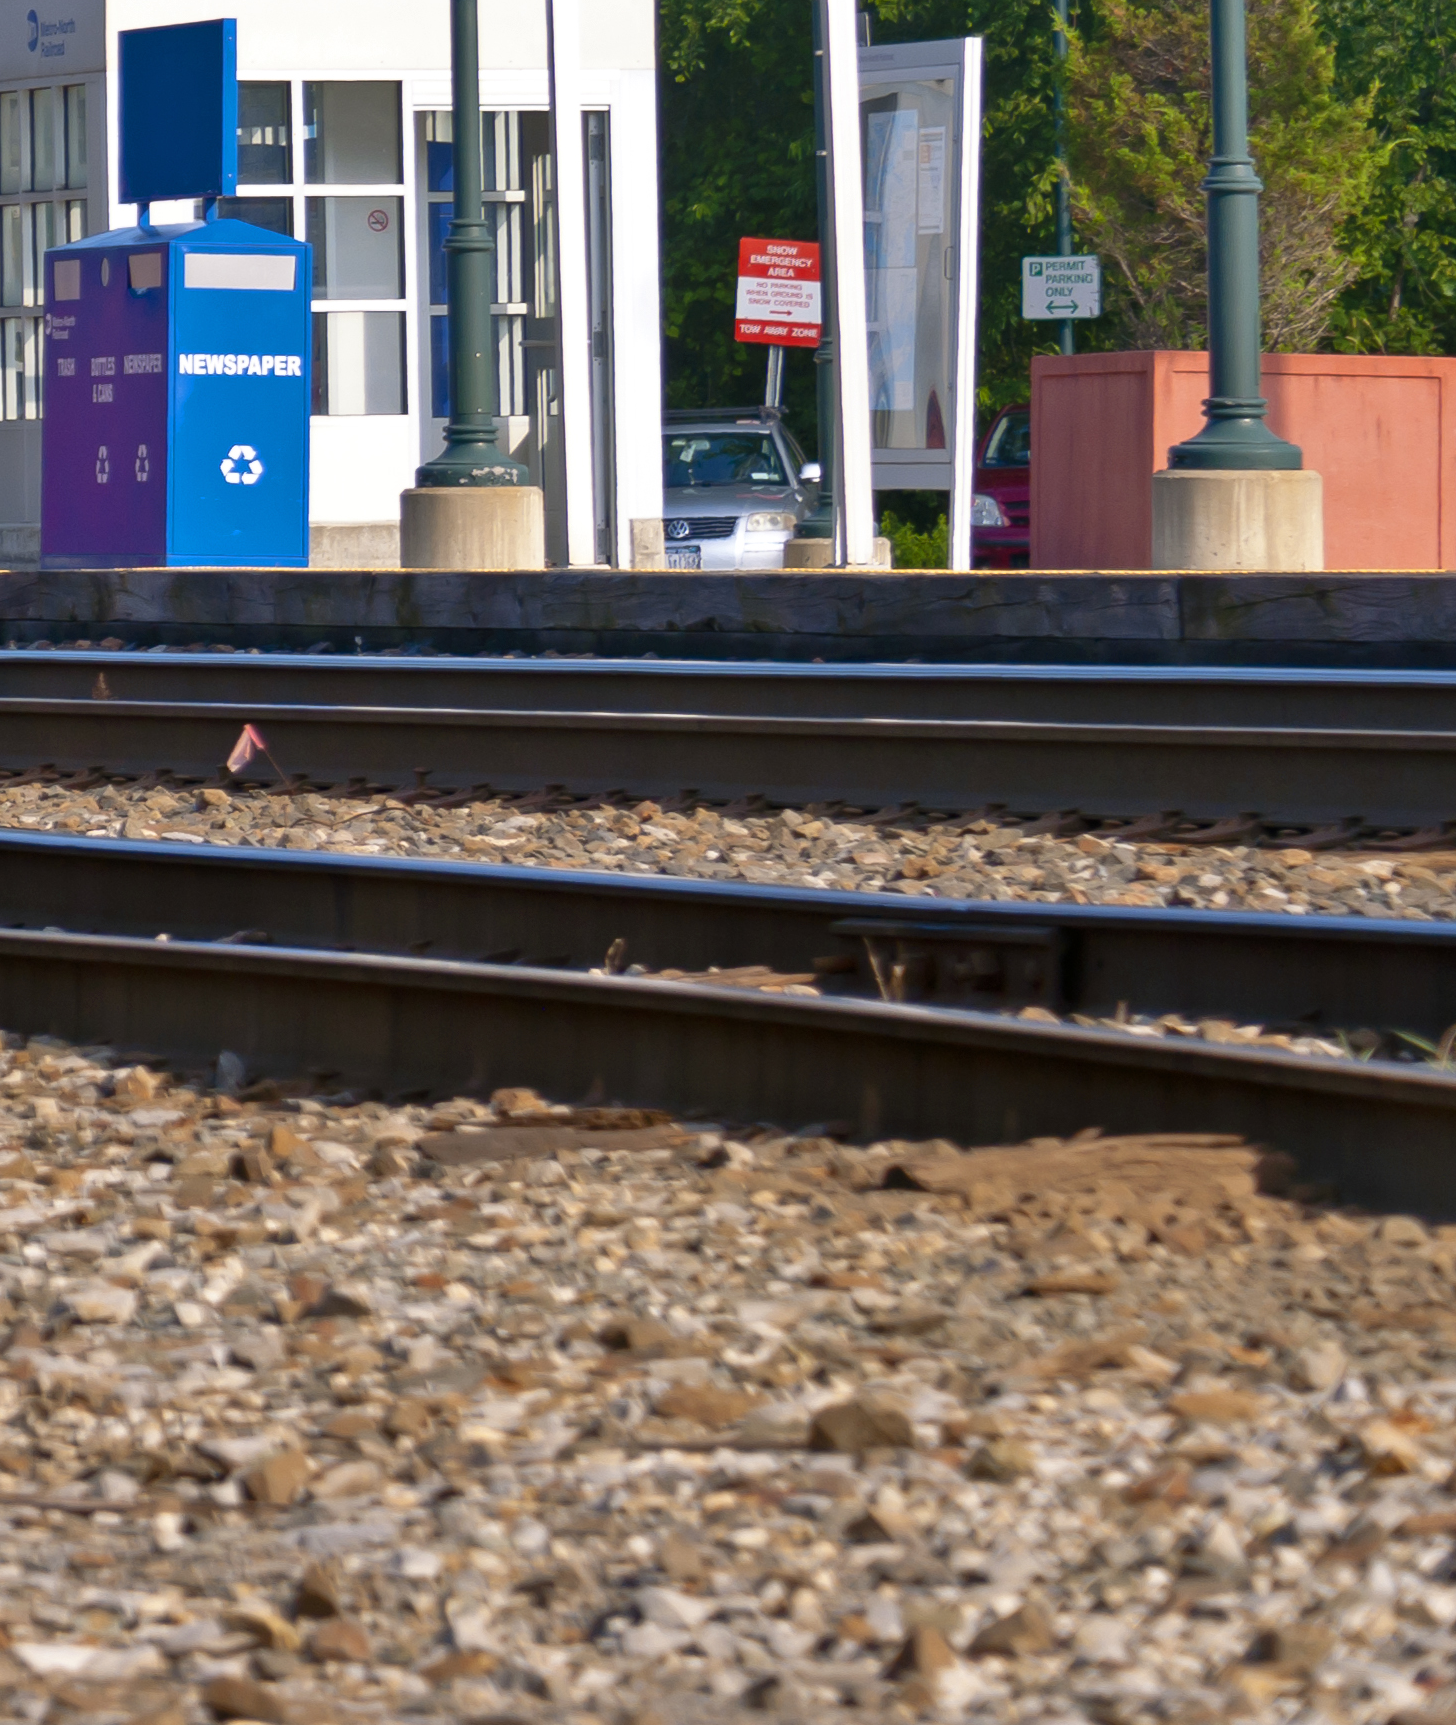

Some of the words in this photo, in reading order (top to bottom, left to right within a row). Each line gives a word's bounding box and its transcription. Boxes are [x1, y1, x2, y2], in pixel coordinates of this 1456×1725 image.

[766, 244, 798, 255] SNOW
[750, 254, 813, 268] EMERGENCY
[1045, 260, 1086, 271] PERMIT
[767, 266, 795, 277] AREA
[1045, 273, 1094, 284] PARKING
[770, 282, 803, 291] PARKING
[1045, 287, 1074, 297] ONLY
[770, 290, 803, 299] GROUND
[748, 297, 771, 305] SNOW
[773, 299, 810, 308] COVERED
[739, 324, 762, 334] TOW
[763, 326, 789, 336] AWAY
[791, 328, 818, 338] ZONE
[123, 353, 163, 375] NEWSPAPER
[178, 353, 302, 377] NEWSPAPER
